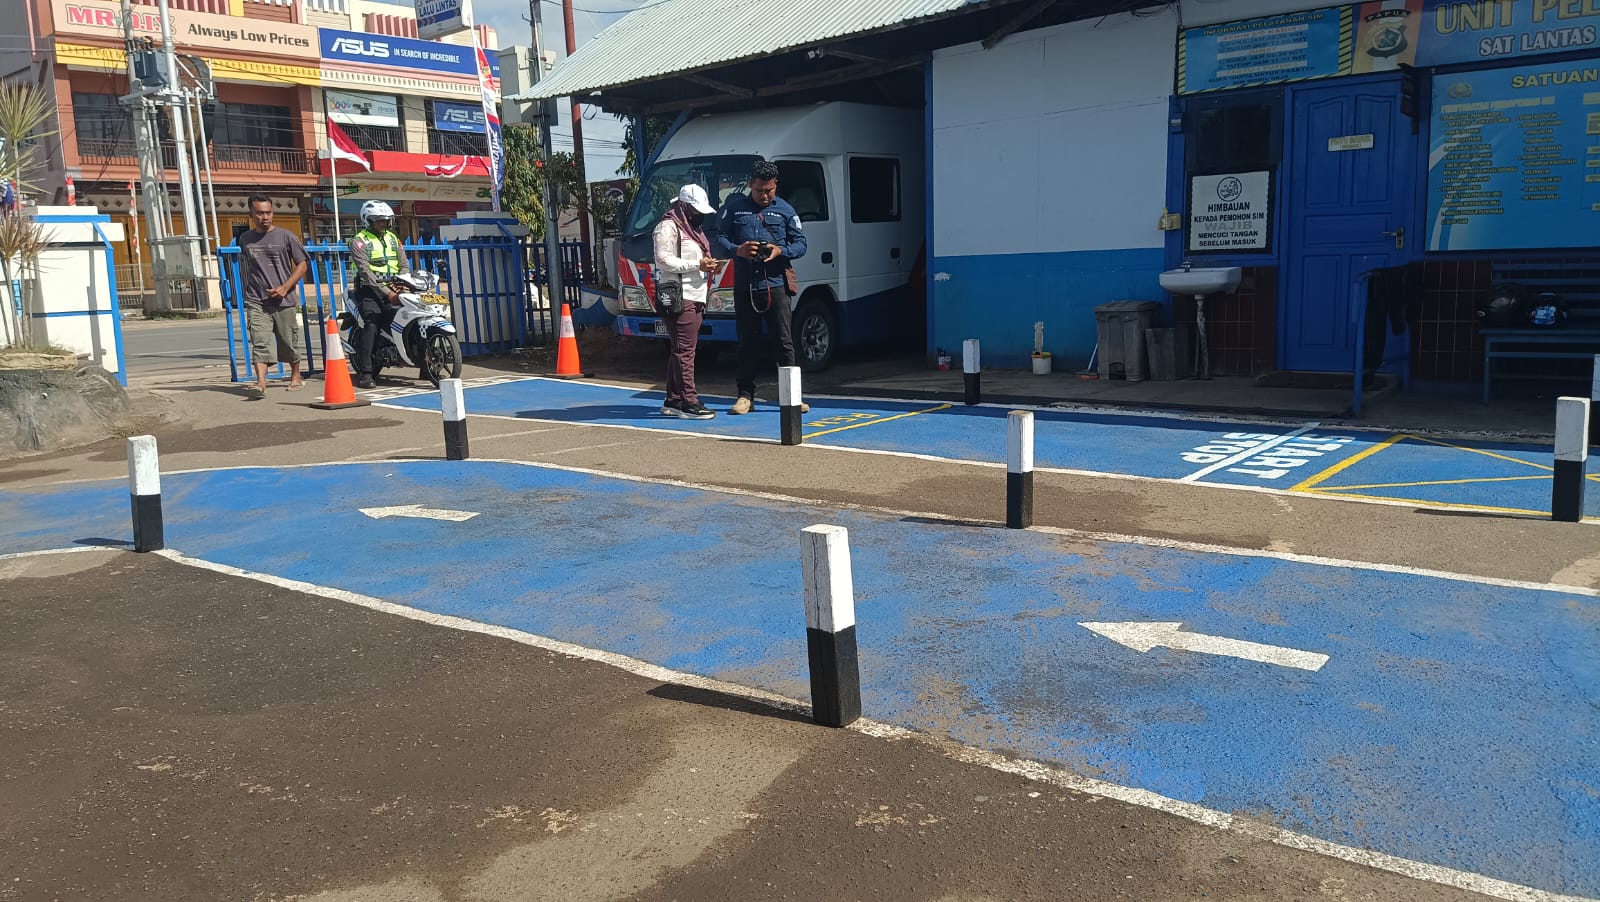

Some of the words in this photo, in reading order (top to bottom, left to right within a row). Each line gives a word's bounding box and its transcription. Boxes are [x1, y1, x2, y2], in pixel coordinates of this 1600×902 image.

[419, 4, 434, 17] LALU
[435, 0, 457, 12] LINTAS
[1367, 9, 1408, 22] PAPUA
[1436, 0, 1517, 34] UNIT
[1203, 24, 1250, 36] INFORMASI
[1252, 17, 1305, 29] PELAYANAN
[1307, 13, 1325, 21] SIM
[188, 23, 238, 41] Always
[241, 29, 267, 42] Low
[269, 32, 309, 47] Prices
[1480, 35, 1514, 56] SAT
[1520, 26, 1596, 52] LANTAS
[330, 38, 390, 58] ASUS
[393, 48, 400, 56] IN
[400, 49, 422, 59] SEARCH
[422, 51, 429, 60] OF
[430, 52, 460, 63] INCREDIBLE
[1512, 68, 1598, 88] SATUAN
[1208, 202, 1250, 212] HIMBAUAN
[1194, 215, 1218, 223] KEPADA
[1220, 213, 1251, 221] PEMOHON
[1204, 221, 1253, 231] WAJIB
[1199, 239, 1230, 247] SEBELUM
[1232, 238, 1256, 246] MASUK
[1179, 432, 1280, 464] STOP
[1225, 433, 1356, 480] START
